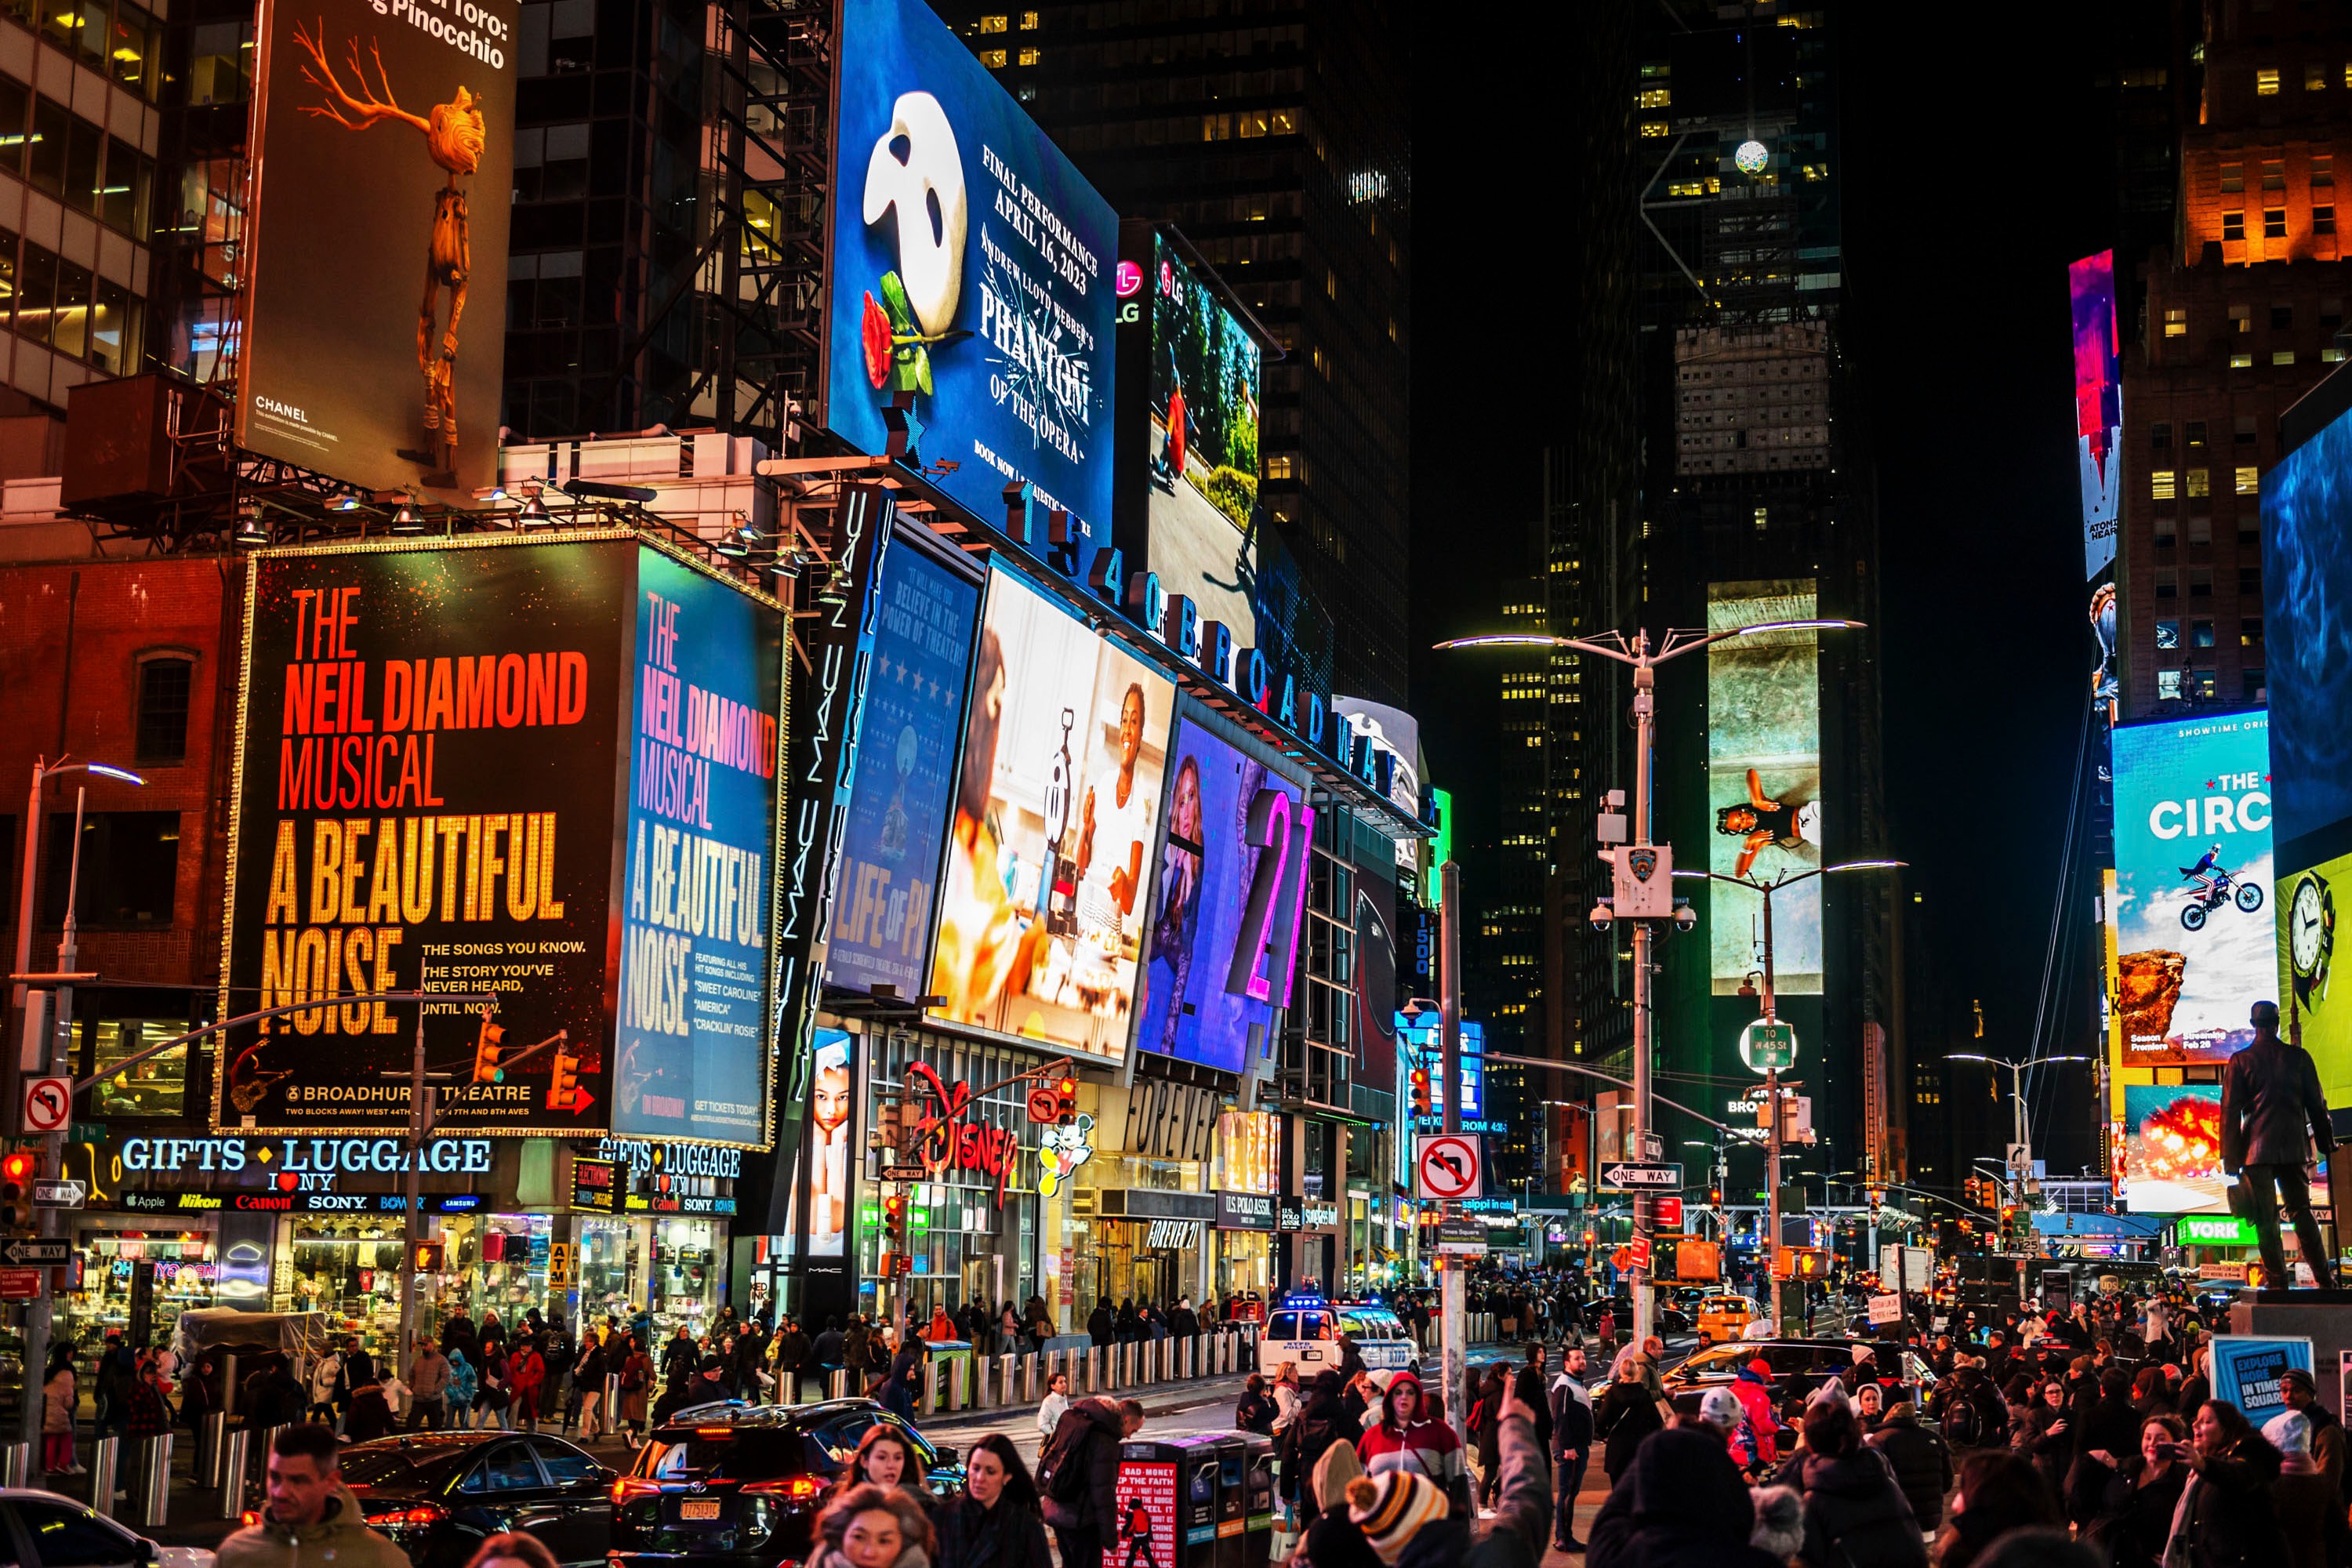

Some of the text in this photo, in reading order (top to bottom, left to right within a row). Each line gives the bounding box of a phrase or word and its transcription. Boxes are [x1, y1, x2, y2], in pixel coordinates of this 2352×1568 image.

[454, 0, 508, 42] Toro:
[392, 0, 504, 69] Pinocchio
[982, 144, 1098, 278] FINAL PERFORMANCE
[994, 188, 1087, 296] APRIL 16, 2023
[981, 222, 1094, 352] ANDREW LLOYD WEBBER'S
[1172, 275, 1183, 307] LG
[979, 282, 1090, 426] PHANTOM
[256, 395, 308, 423] CHANEL
[990, 373, 1079, 465] OF THE OPERA
[975, 439, 1015, 481] BOOK NOW
[895, 580, 959, 637] BELIEVE IN THE
[292, 587, 361, 660] THE
[647, 590, 681, 673] THE
[881, 602, 924, 644] POWER OF
[1004, 481, 1397, 797] 1540 BROADWAY
[283, 652, 588, 736] NEIL DIAMOND
[641, 670, 776, 779] NEIL DIAMOND
[2179, 724, 2238, 738] SHOWTIME
[278, 733, 445, 811] MUSICAL
[637, 737, 713, 831] MUSICAL
[2219, 771, 2259, 792] THE
[2149, 791, 2272, 840] CIRC
[264, 811, 564, 925] A BEAUTIFUL
[630, 818, 764, 949] A BEAUTIFUL
[835, 856, 931, 960] LIFE OF PI
[1239, 789, 1315, 1010] 21
[422, 942, 586, 956] THE SONGS YOU KNOW.
[1415, 913, 1428, 975] 1500
[423, 964, 554, 978] THE STORY YOU'VE
[695, 953, 747, 971] FEATURING ALL HIS
[695, 964, 754, 983] HIT SONGS INCLUDING
[259, 927, 404, 1036] NOISE
[423, 980, 524, 993] NEVER HEARD,
[625, 924, 691, 1037] NOISE
[423, 1002, 502, 1014] UNTIL NOW.
[1755, 1041, 1788, 1050] W 45 St
[1765, 1029, 1777, 1038] TO
[2131, 1034, 2161, 1043] Season
[2182, 1031, 2226, 1042] Streaming
[2183, 1041, 2199, 1050] Feb
[2131, 1042, 2169, 1051] Premiere
[442, 1086, 531, 1101] THEATRE
[695, 1100, 709, 1112] GET
[709, 1102, 735, 1114] TICKETS
[1123, 1079, 1220, 1163] FOREVER
[122, 1138, 491, 1173] GIFTS LUGGAGE
[599, 1137, 741, 1178] GIFTS LUGGAGE
[297, 1173, 336, 1191] NY
[669, 1174, 687, 1192] NY
[1613, 1171, 1671, 1181] ONE WAY
[37, 1189, 78, 1200] ONE WAY
[138, 1196, 165, 1208] Apple
[178, 1193, 222, 1208] Nikon
[236, 1194, 296, 1210] Canon
[309, 1196, 366, 1209] SONY
[626, 1194, 735, 1212] Nikon Canon SONY BOWER
[1225, 1196, 1271, 1216] U.S. POLO ASSN.
[1305, 1203, 1338, 1230] sunglass hut
[1146, 1219, 1200, 1249] FOREVER 21
[1459, 1229, 1480, 1238] Square
[2188, 1221, 2239, 1239] YORK
[11, 1247, 62, 1257] ONE WAY
[2024, 1241, 2038, 1250] 25
[551, 1246, 564, 1283] ATM
[2101, 1280, 2118, 1291] ups
[2236, 1353, 2284, 1371] EXPLORE
[2240, 1369, 2270, 1384] MORE
[2241, 1384, 2254, 1396] IN
[1145, 1468, 1174, 1476] MONEY
[1149, 1477, 1174, 1486] FAITH
